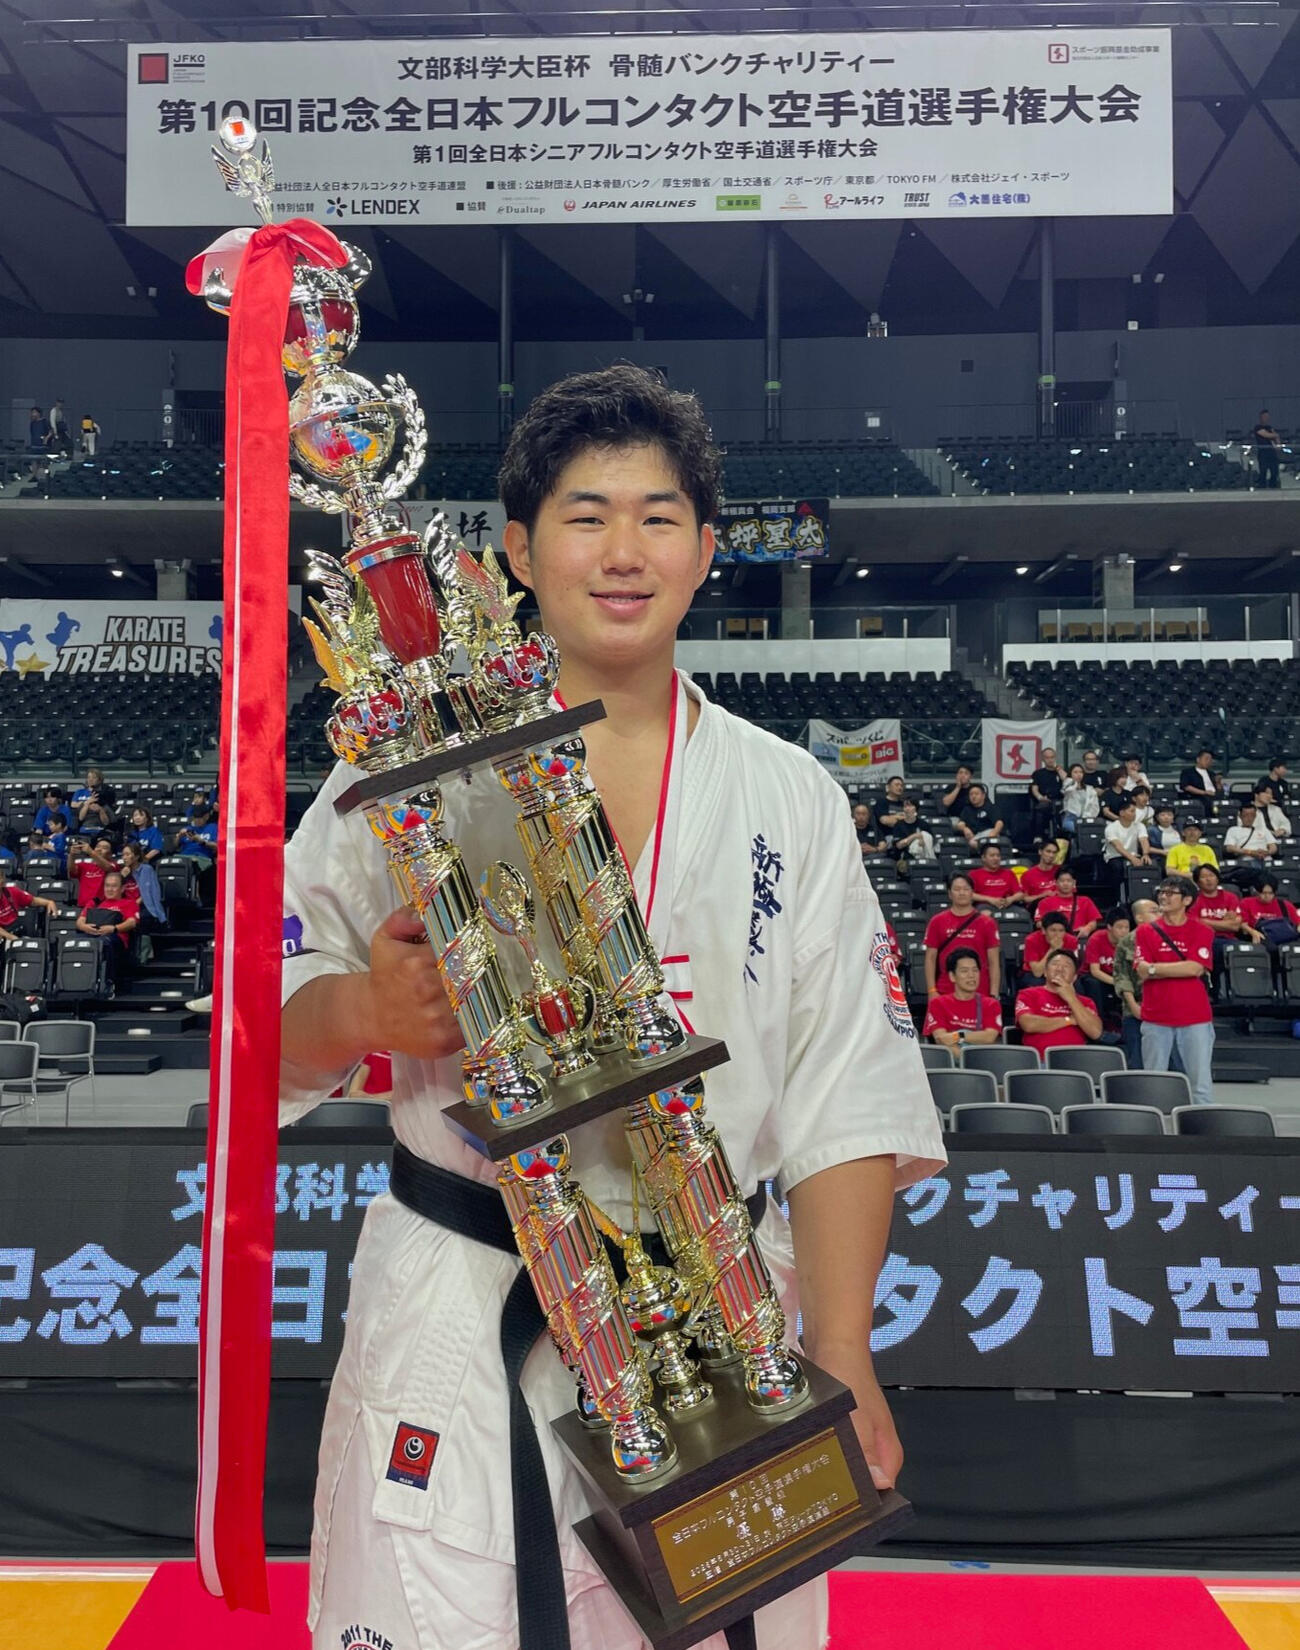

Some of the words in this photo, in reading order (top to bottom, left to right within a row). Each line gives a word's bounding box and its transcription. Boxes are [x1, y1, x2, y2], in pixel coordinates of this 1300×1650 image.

[173, 54, 206, 63] JFKO
[397, 54, 590, 79] 文部科学大臣杯
[609, 51, 895, 79] 骨髄バンクチャリティー
[157, 84, 1142, 135] 第10回記念全日本フルコンタクト空手道選手権大会
[412, 139, 878, 164] 第1回全日本シニアフルコンタクト空手道選手権大会
[277, 202, 315, 213] 特別協賛
[351, 199, 421, 215] LENDEX
[581, 200, 627, 209] JAPAN
[630, 199, 697, 209] AIRLINES
[904, 192, 930, 203] TRUST
[104, 616, 186, 644] KARATE
[58, 644, 223, 677] TREASURES
[170, 1162, 391, 1222] 文科学
[869, 1252, 1300, 1357] タクト空
[341, 1624, 361, 1649] 2011
[364, 1627, 393, 1650] THE
